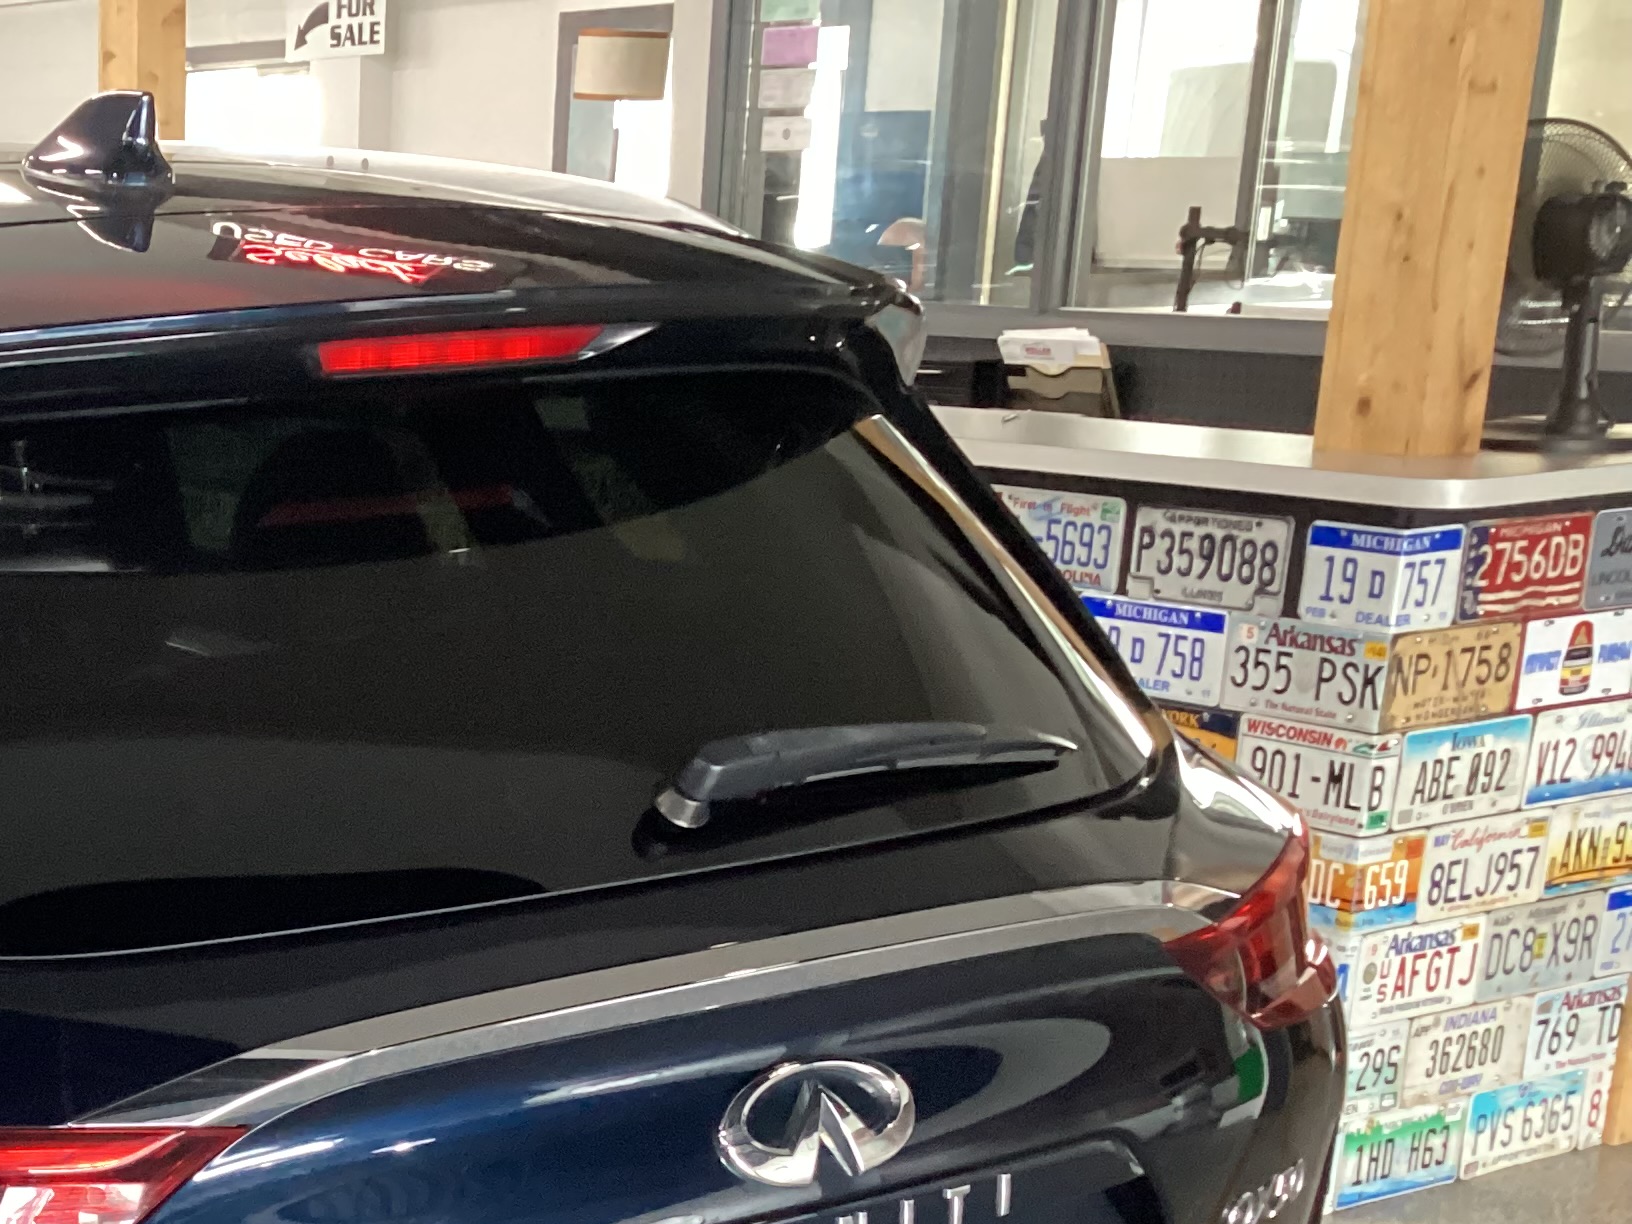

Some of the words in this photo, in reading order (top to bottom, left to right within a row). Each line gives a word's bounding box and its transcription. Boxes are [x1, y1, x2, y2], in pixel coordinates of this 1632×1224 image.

[330, 21, 380, 48] SALE
[336, 0, 375, 19] FOR
[1032, 518, 1112, 569] -5693
[1136, 525, 1278, 587] P359088
[1350, 532, 1431, 550] MICHIGAN
[1471, 533, 1586, 588] 2756DB
[1319, 555, 1358, 605] 19
[1369, 569, 1385, 599] D
[1401, 558, 1446, 610] 757
[1114, 603, 1189, 625] MICHIGAN
[1355, 611, 1411, 627] DEALER
[1130, 637, 1145, 664] D
[1156, 631, 1205, 682] 758
[1264, 622, 1359, 657] Arkansas
[1137, 678, 1171, 691] ALER
[1230, 645, 1293, 694] 355
[1314, 656, 1385, 711] PSK
[1246, 718, 1334, 748] WISCONSIN
[1536, 739, 1577, 787] V12
[1589, 729, 1632, 779] 994
[1410, 755, 1461, 805] ABE
[1309, 859, 1345, 908] DC
[1364, 860, 1410, 910] 659
[1428, 845, 1540, 906] 8ELJ957
[1384, 928, 1457, 958] Arkansas
[1485, 927, 1536, 980] DC8
[1546, 914, 1598, 968] X9R
[1390, 943, 1479, 1000] AFGTJ
[1443, 1007, 1497, 1032] INDIANA
[1558, 985, 1621, 1014] Arkansas
[1425, 1025, 1505, 1078] 362680
[1535, 1012, 1580, 1060] 769
[1471, 1106, 1515, 1156] PVS
[1521, 1089, 1577, 1142] 6365
[1408, 1124, 1450, 1173] H63
